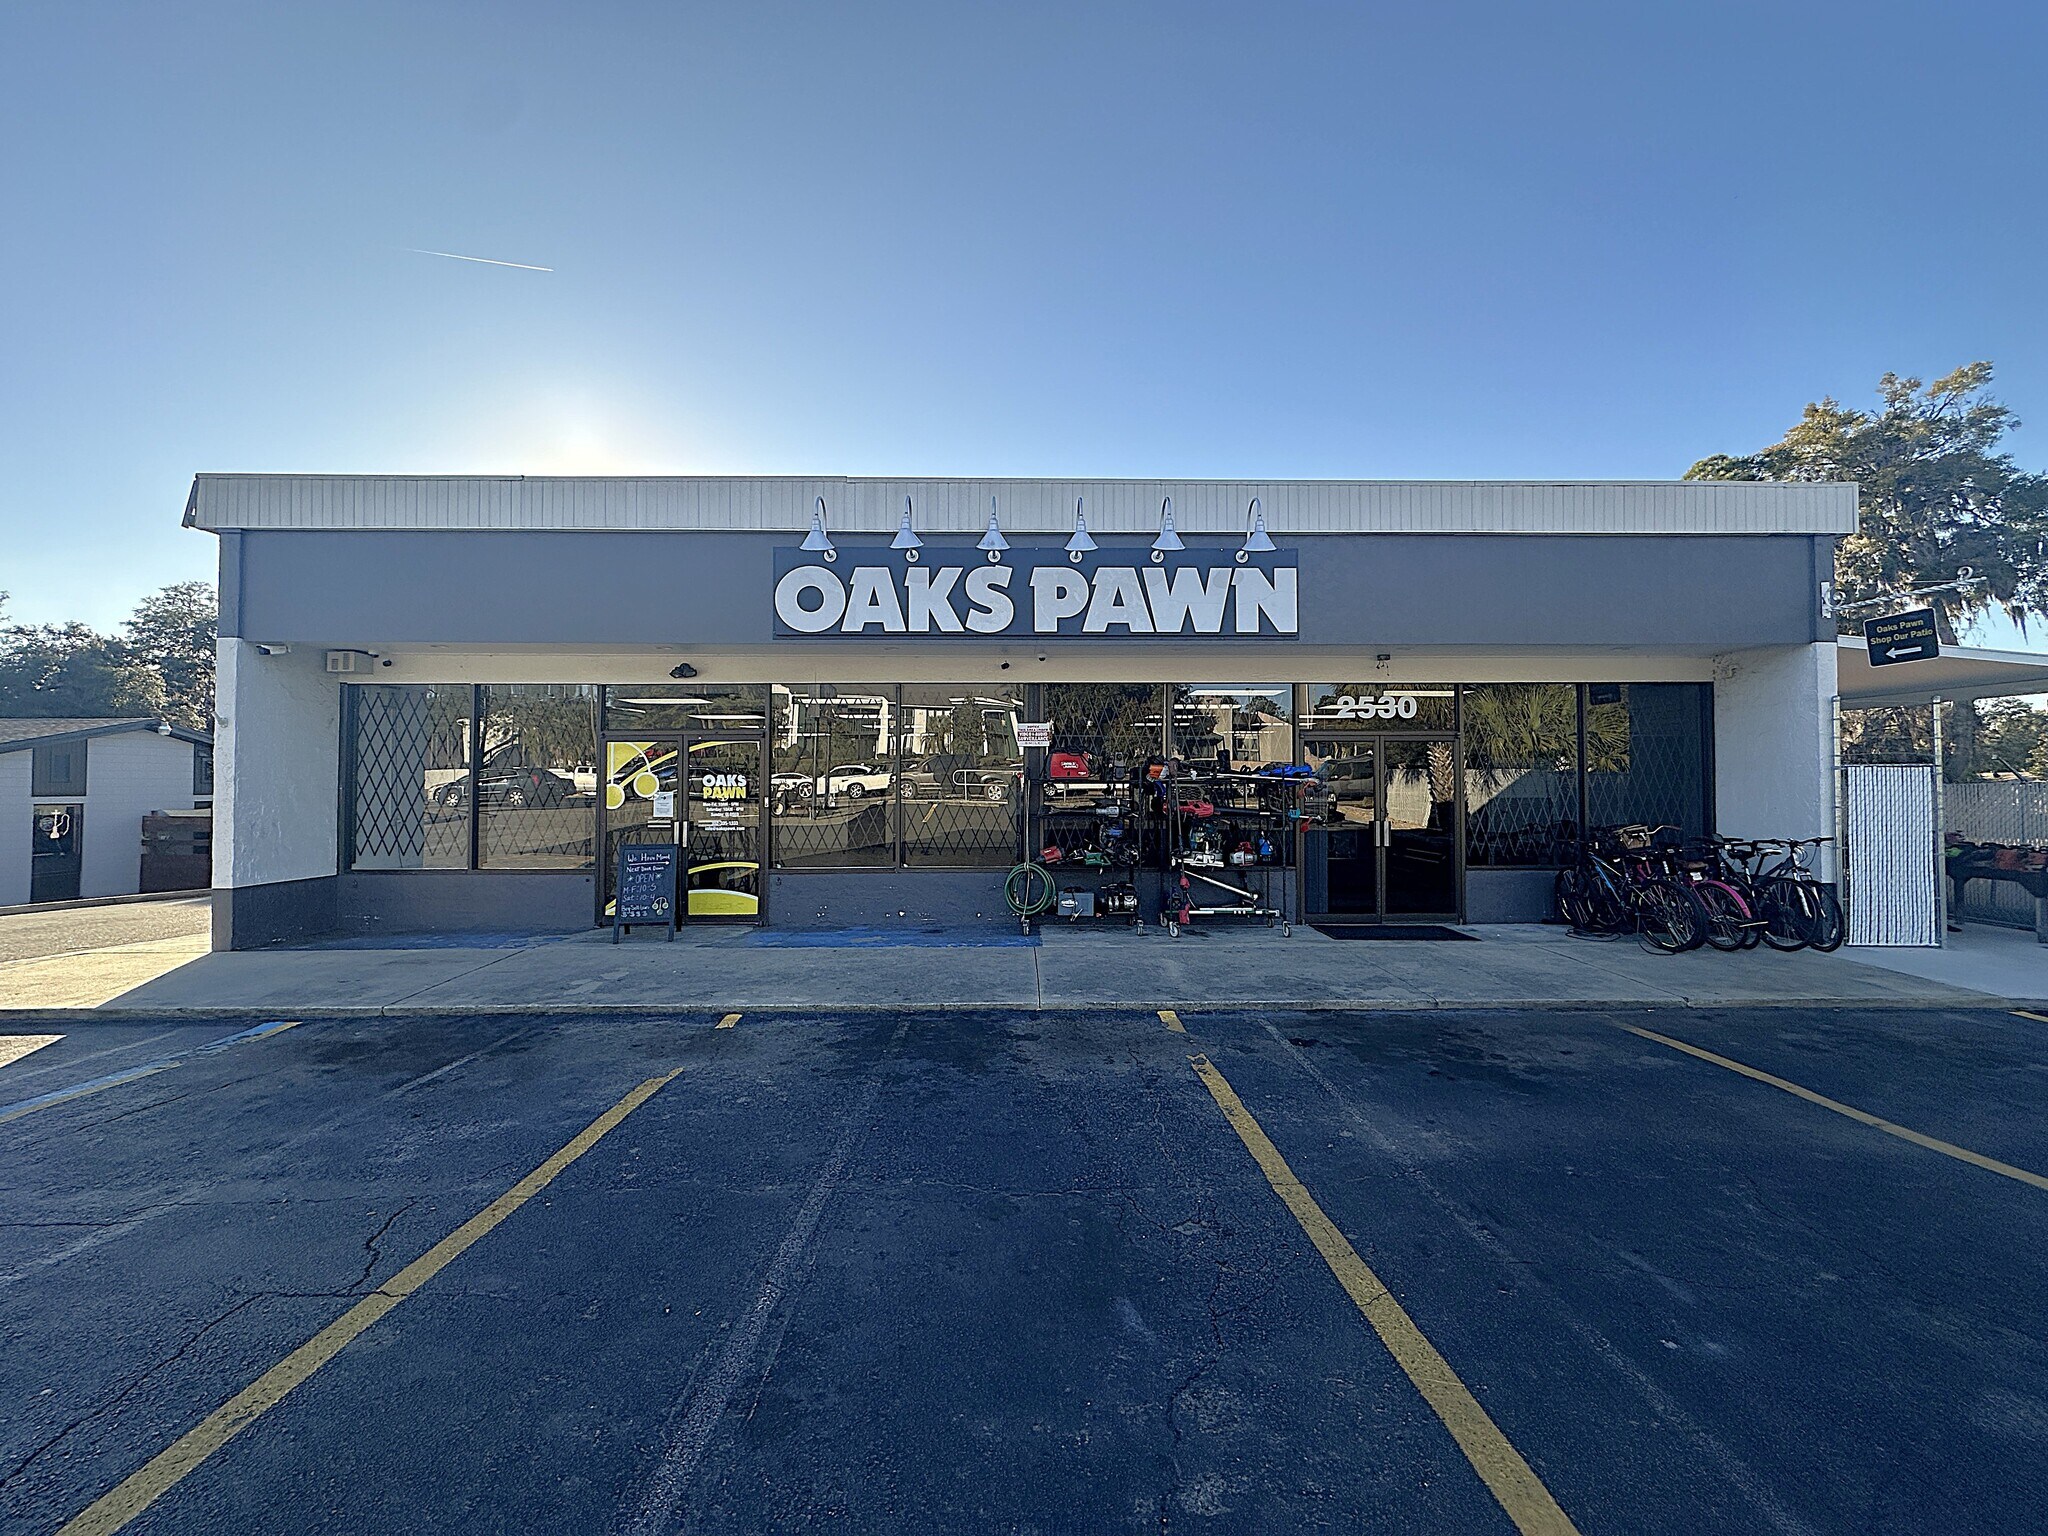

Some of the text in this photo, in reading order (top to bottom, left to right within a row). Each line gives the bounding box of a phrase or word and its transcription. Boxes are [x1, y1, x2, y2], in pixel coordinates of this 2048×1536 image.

[775, 564, 1298, 633] OAKS PAWN
[1876, 619, 1924, 633] Oaks Pawn
[1870, 628, 1933, 645] Shop Our Patio
[1337, 695, 1417, 719] 2530
[702, 774, 747, 787] OAKS
[702, 786, 747, 799] PAWN
